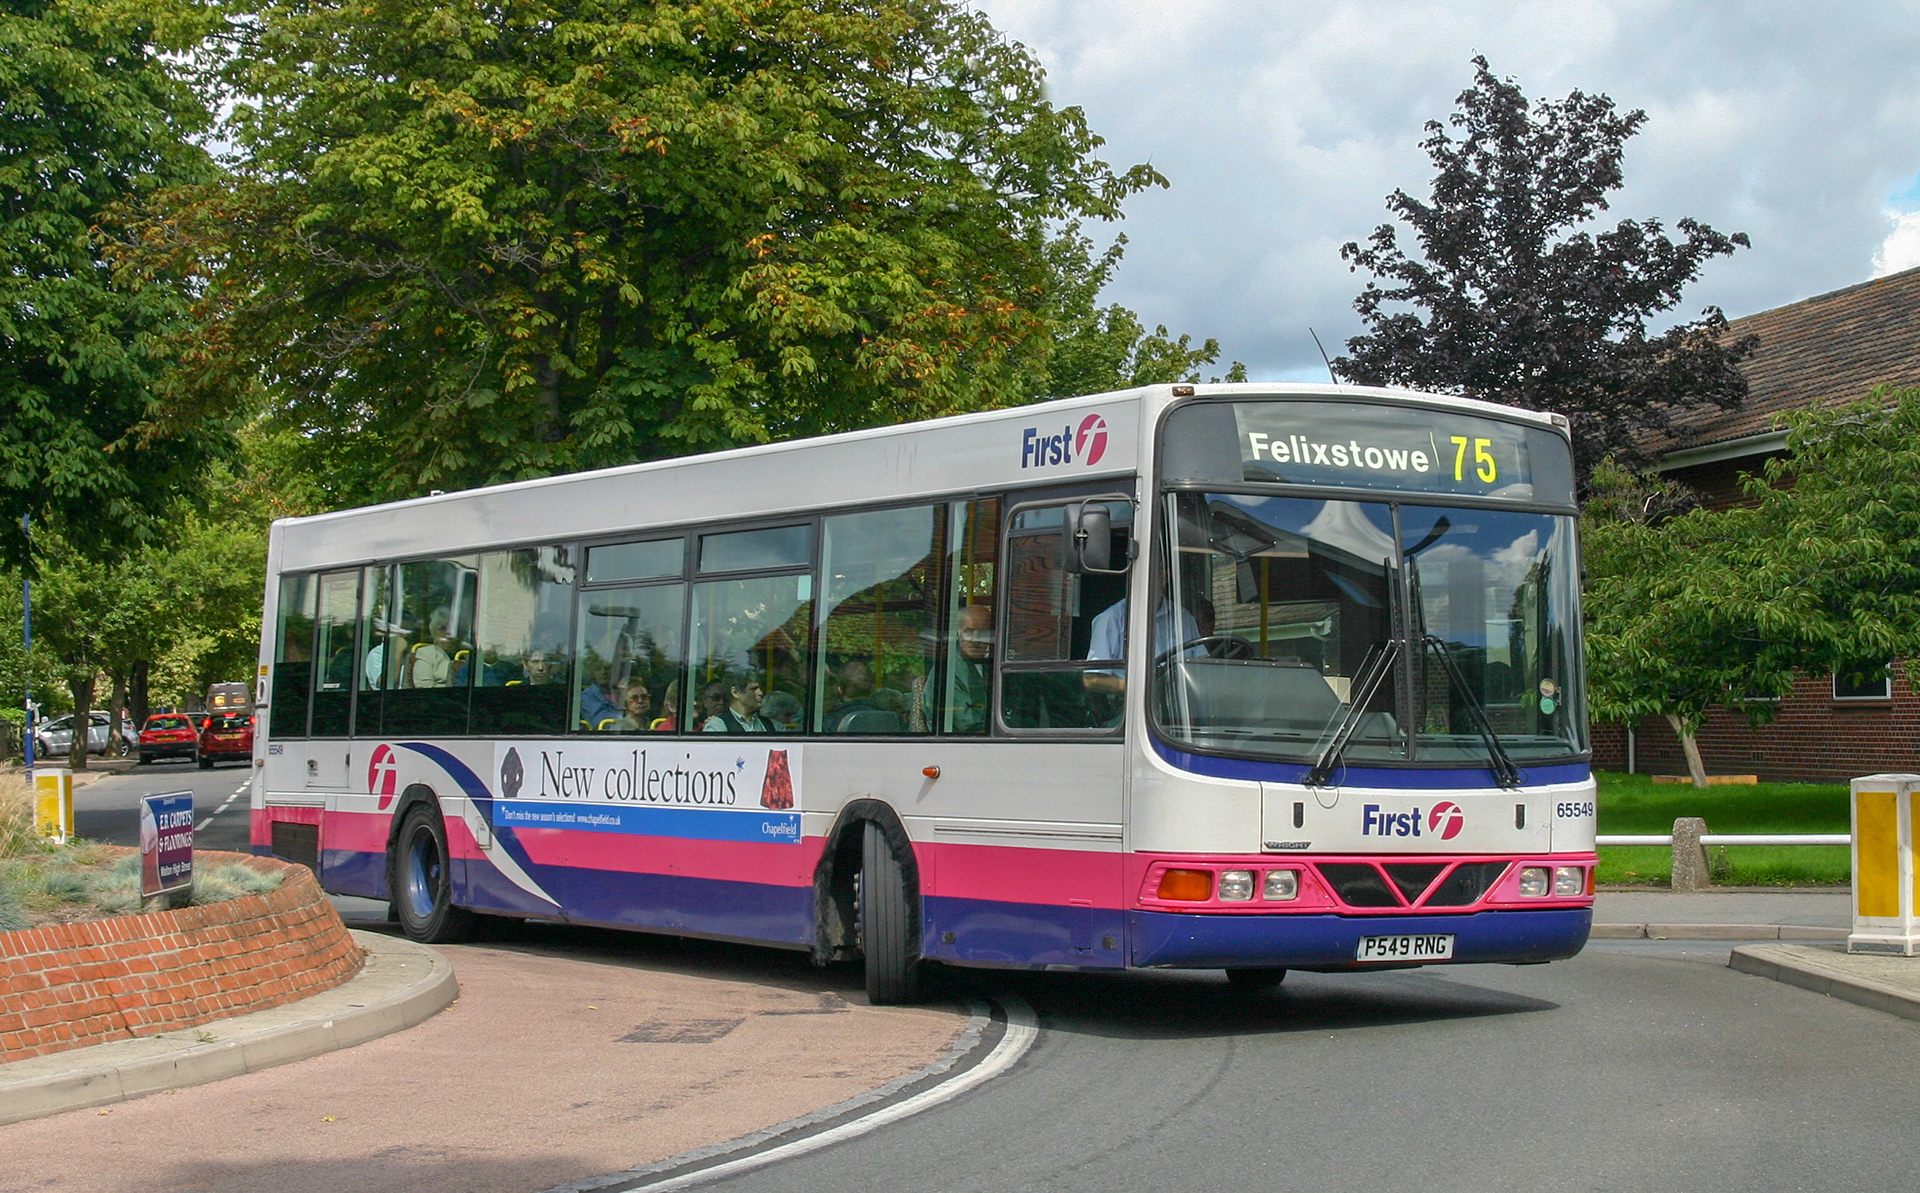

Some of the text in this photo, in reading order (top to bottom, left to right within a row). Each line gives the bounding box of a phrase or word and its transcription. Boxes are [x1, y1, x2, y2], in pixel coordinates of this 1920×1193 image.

[1021, 425, 1073, 469] First
[1248, 431, 1430, 473] Felixstowe
[1450, 435, 1498, 484] 75
[539, 749, 737, 806] New collections
[170, 810, 192, 828] CARPETS
[532, 813, 540, 821] new
[1556, 802, 1594, 818] 65549
[761, 822, 797, 838] Chapelfield
[1362, 804, 1422, 837] First
[1266, 841, 1310, 849] WRIGHT
[1364, 936, 1447, 956] P549 RNG
